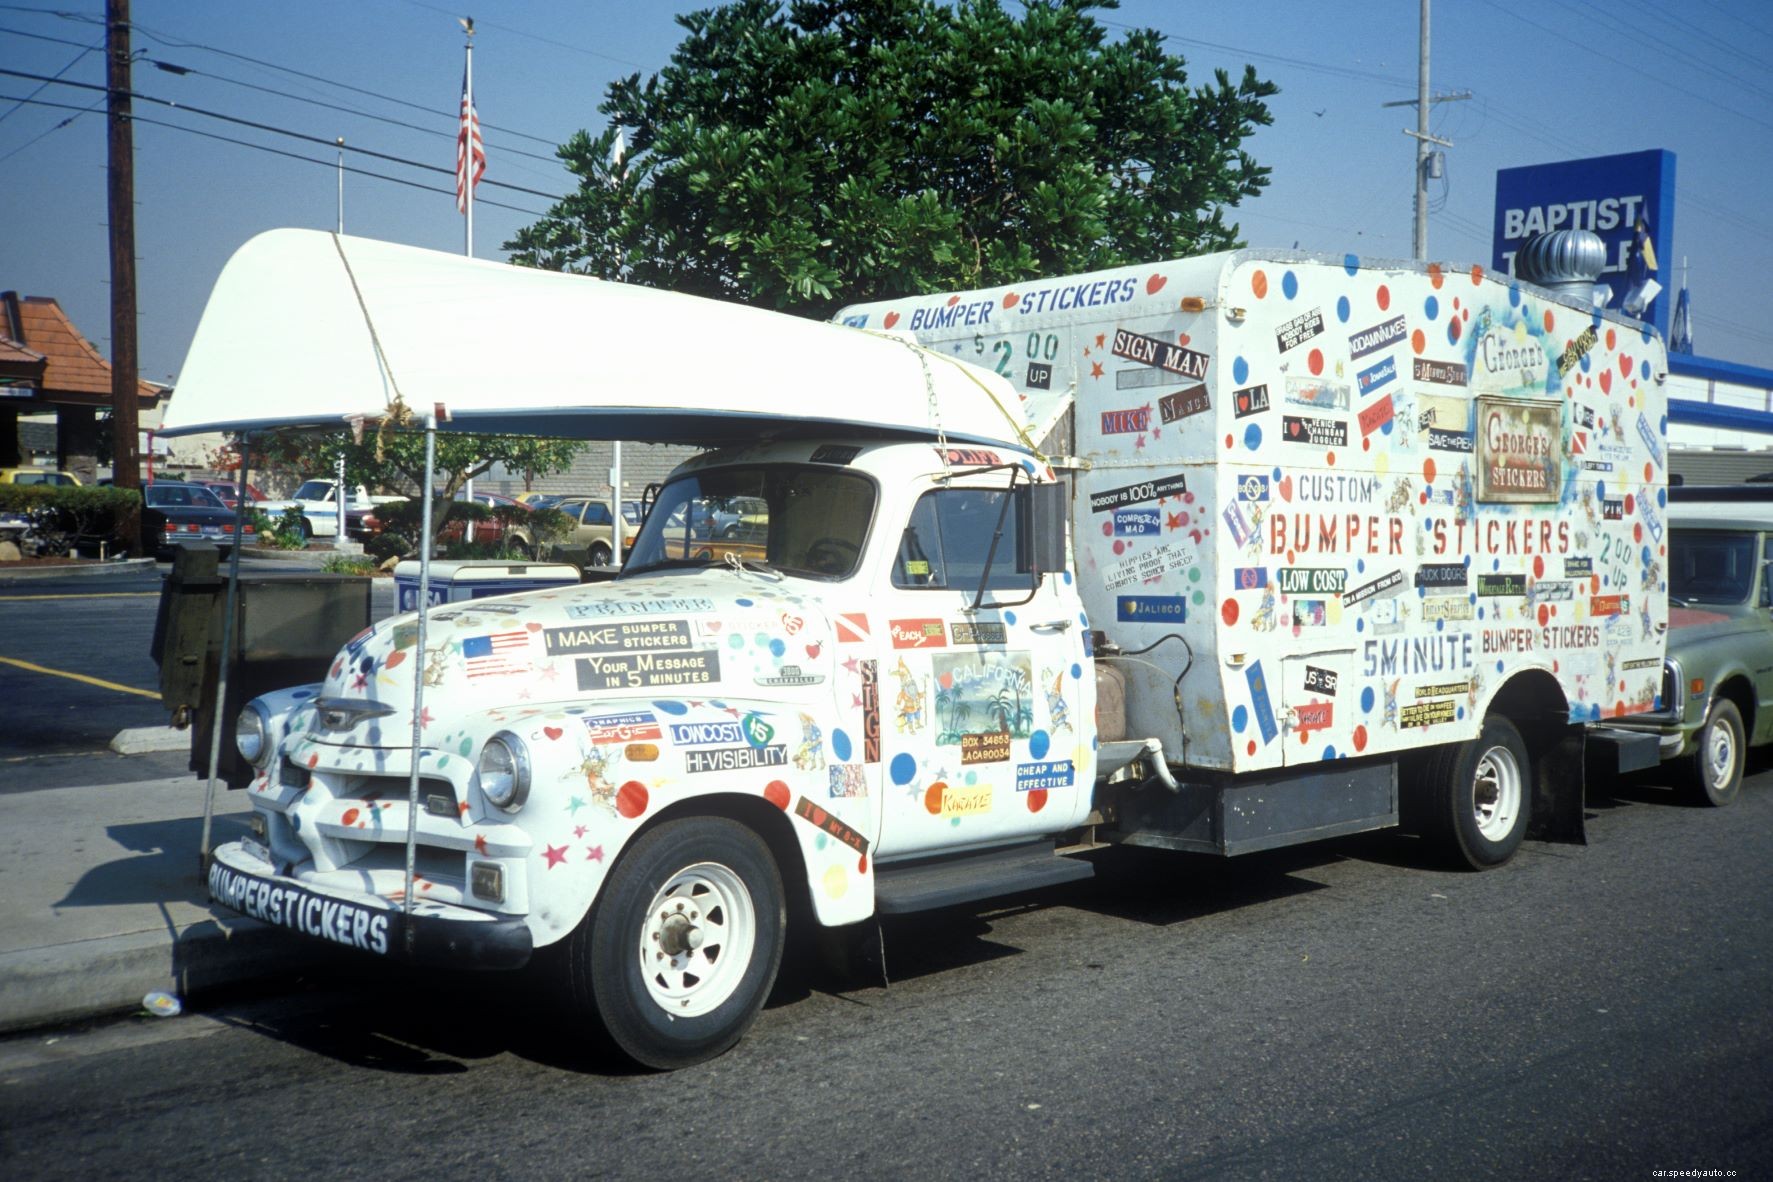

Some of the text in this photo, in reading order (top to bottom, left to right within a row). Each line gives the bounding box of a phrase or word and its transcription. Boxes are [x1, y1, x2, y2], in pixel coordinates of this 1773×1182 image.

[1504, 195, 1643, 239] BAPTIST
[910, 277, 1138, 331] BUMPER STICKERS
[1286, 329, 1315, 349] FOR FREE
[1114, 331, 1209, 378] SIGN MAN
[1030, 369, 1048, 383] UP
[1234, 394, 1240, 414] I
[1250, 390, 1270, 410] LA
[1284, 422, 1288, 433] I
[1312, 418, 1336, 429] VENICE
[1308, 424, 1344, 437] CHAINSAW
[1488, 411, 1548, 455] GEORGE'S
[1310, 434, 1343, 446] JUGGLER
[1429, 434, 1447, 448] SAVE
[1492, 468, 1545, 489] STICKERS
[1091, 481, 1184, 507] NOBODY IS 100% ANYTHING
[1299, 475, 1373, 504] CUSTOM
[1125, 525, 1144, 533] MAD
[1270, 513, 1570, 555] BUMPER STICKERS
[1139, 556, 1162, 572] PROOF
[1167, 547, 1187, 560] THAT
[1169, 555, 1193, 570] SHEEP
[1281, 569, 1310, 592] LOW
[1313, 568, 1345, 591] COST
[1377, 577, 1391, 589] FROM
[1392, 572, 1402, 583] GOD
[1441, 567, 1467, 581] DOORS
[574, 599, 711, 617] PRINTER
[1138, 601, 1181, 614] JALISCO
[546, 624, 677, 647] I MAKE BUMPER
[624, 636, 688, 648] STICKERS
[1482, 629, 1533, 653] BUMPER
[1543, 625, 1599, 649] STICKERS
[589, 654, 705, 674] YOUR MESSAGE
[606, 671, 709, 688] IN 5 MINUTES
[952, 664, 1031, 693] CALIFORNIA
[862, 662, 880, 762] SIGN
[671, 724, 740, 743] LOWCOST
[962, 738, 979, 747] BOX
[686, 747, 787, 771] HI-VISIBILITY
[1017, 763, 1068, 776] CHEAP AND
[1018, 777, 1068, 789] EFFECTIVE
[208, 863, 389, 955] BUMPERSTICKERS
